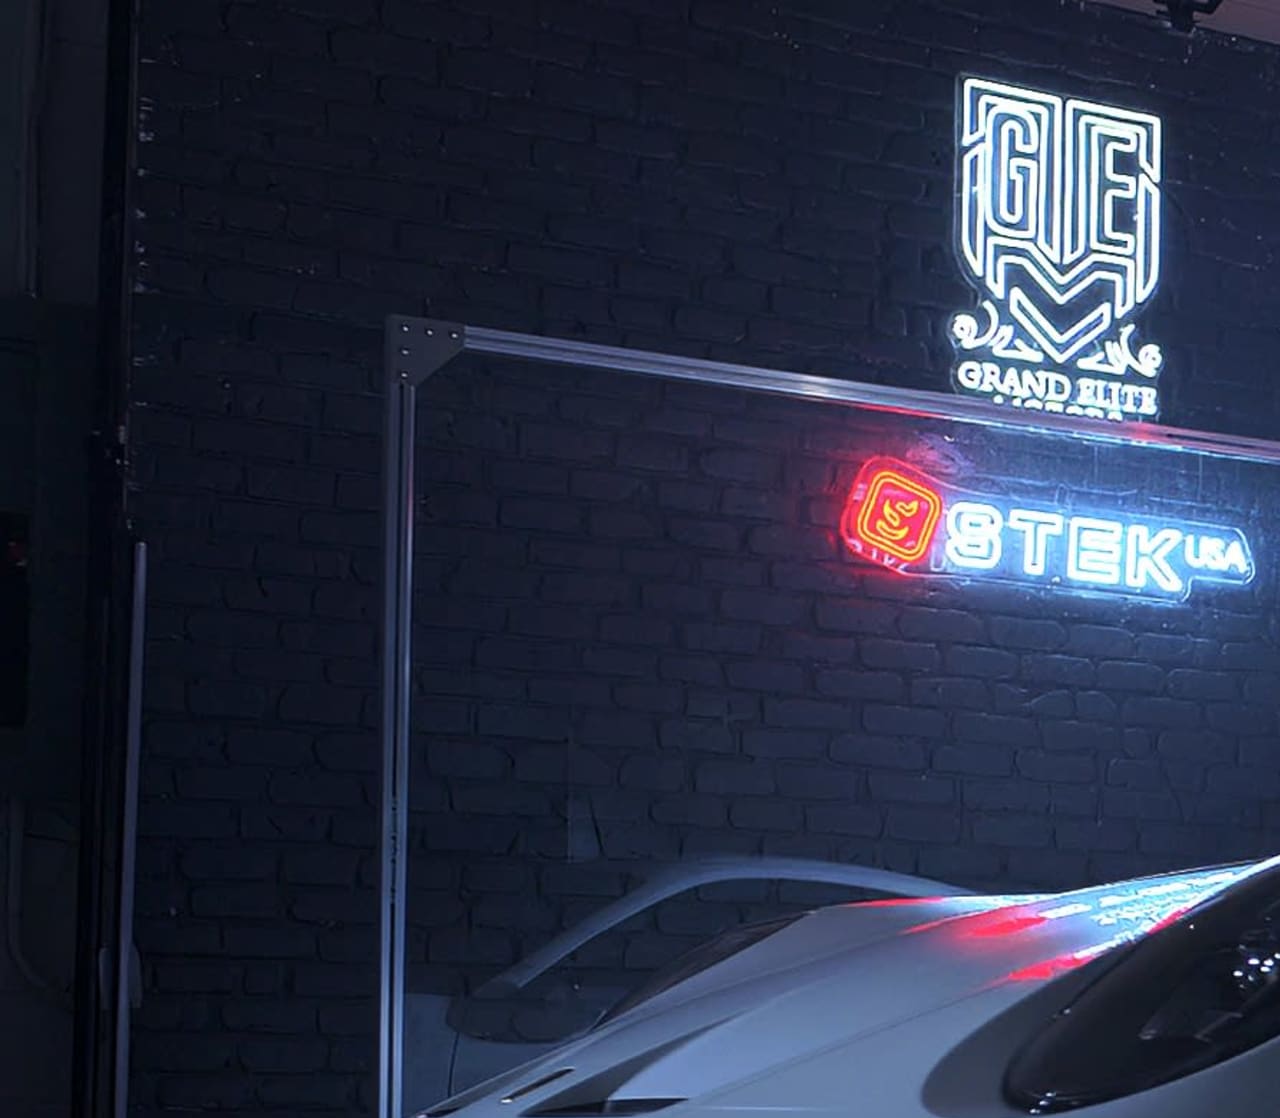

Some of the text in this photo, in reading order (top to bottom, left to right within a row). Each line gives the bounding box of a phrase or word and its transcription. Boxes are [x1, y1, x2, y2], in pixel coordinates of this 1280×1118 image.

[958, 361, 1072, 402] GRAND
[1076, 378, 1158, 415] ELITE
[946, 502, 1248, 592] STEK USA
